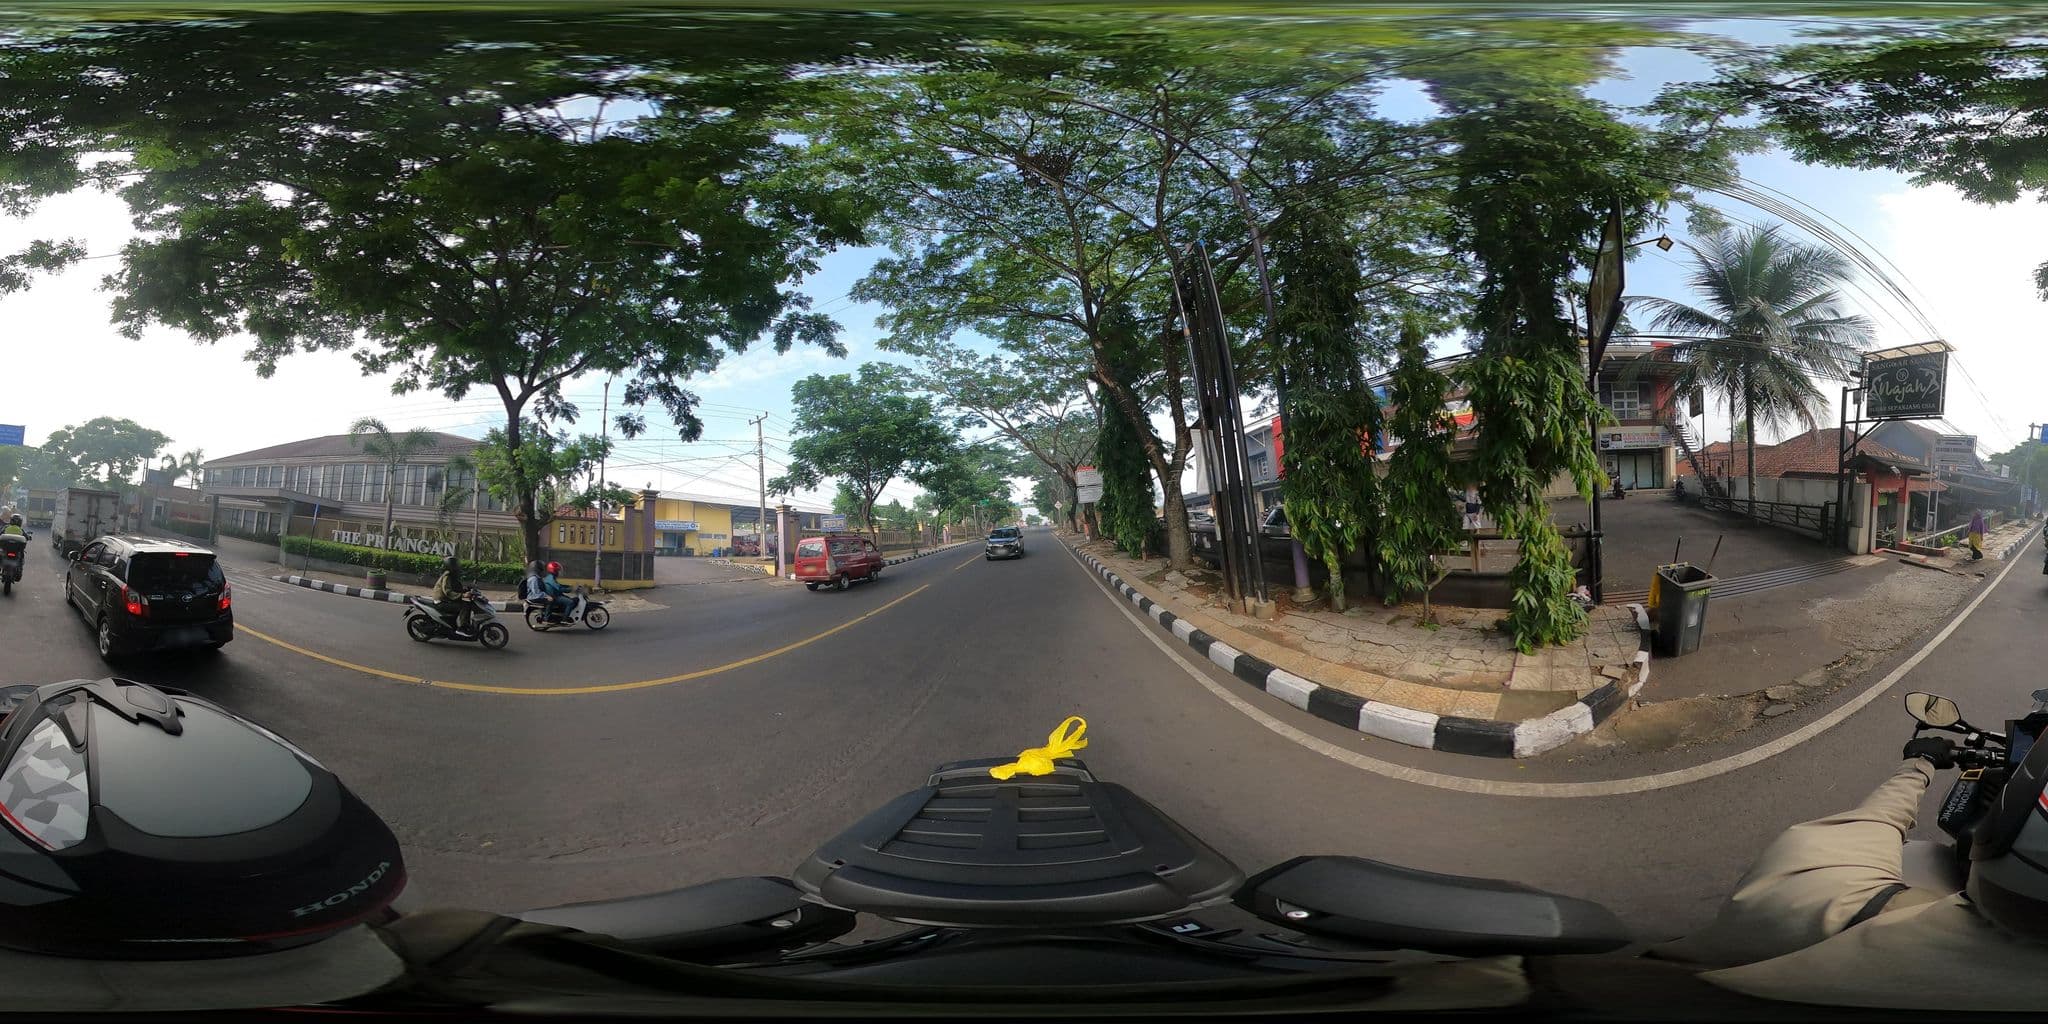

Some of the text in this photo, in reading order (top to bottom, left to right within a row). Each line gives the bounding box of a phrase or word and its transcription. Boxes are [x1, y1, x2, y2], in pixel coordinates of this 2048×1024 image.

[332, 529, 456, 557] THE PRIANGAN
[292, 862, 390, 916] HONDA
